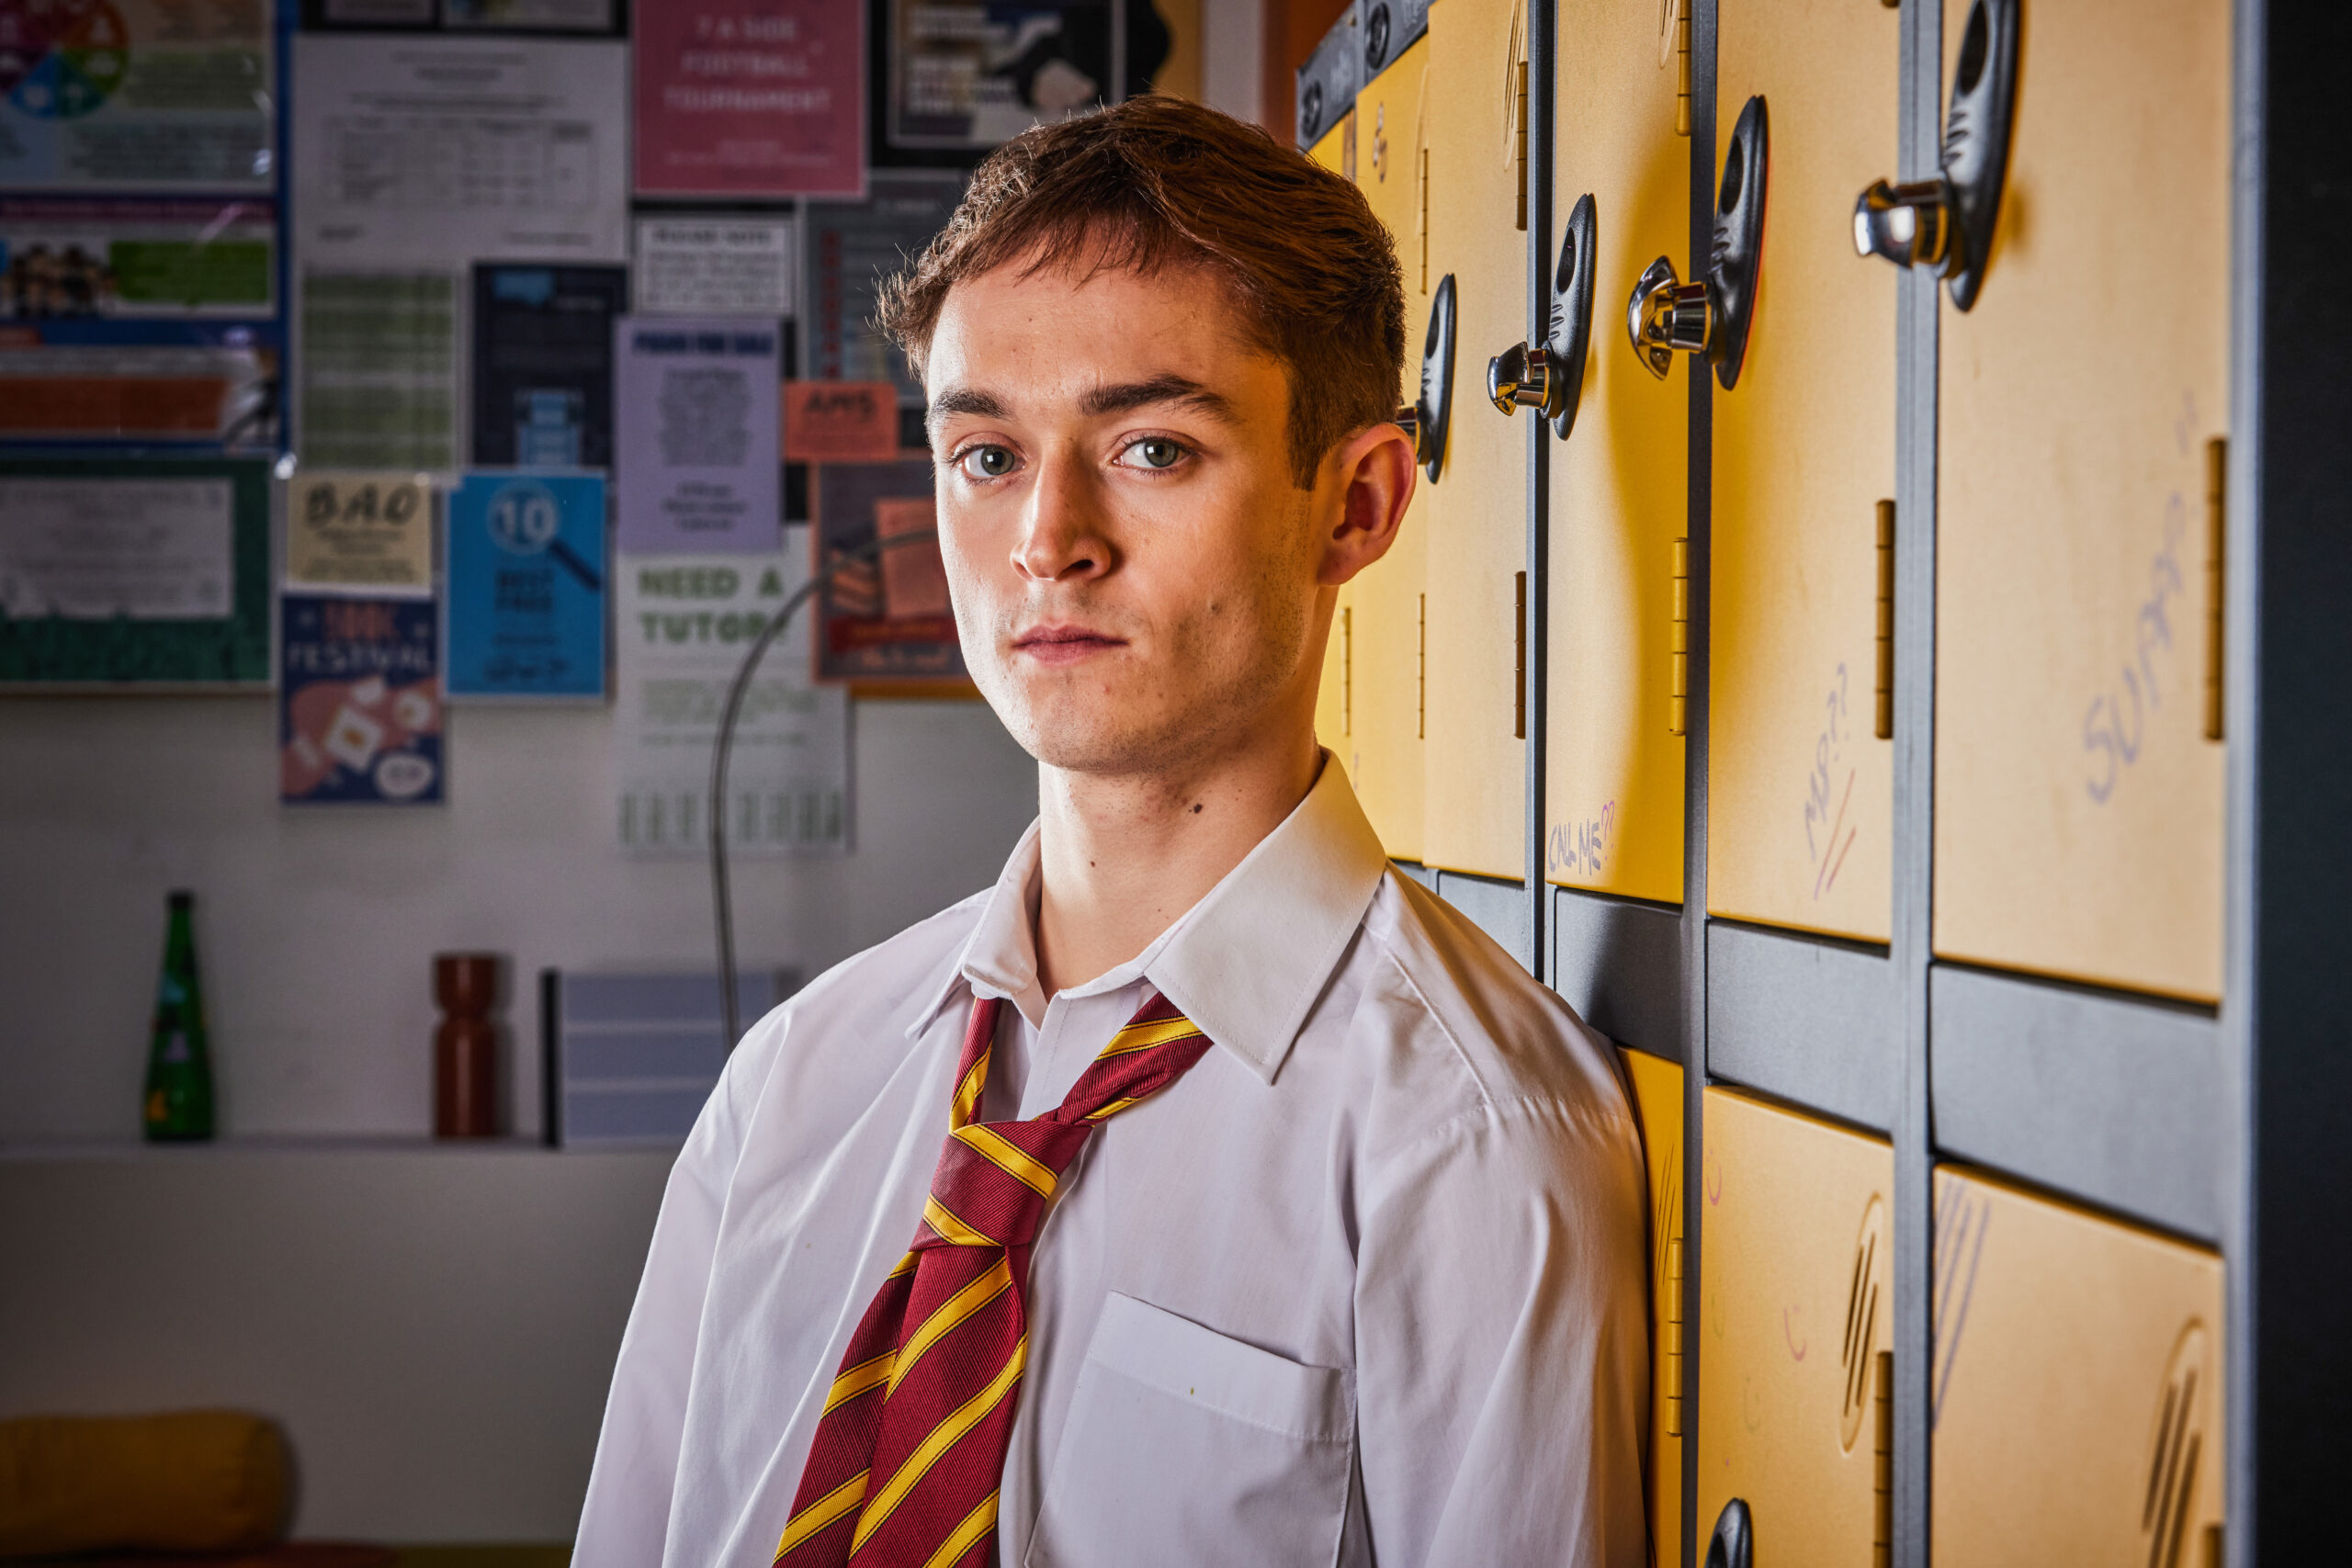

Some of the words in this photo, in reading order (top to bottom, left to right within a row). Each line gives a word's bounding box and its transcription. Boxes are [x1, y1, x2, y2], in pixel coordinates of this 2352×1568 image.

[680, 51, 811, 78] FOOTBALL
[662, 85, 831, 113] TOURNAMENT
[497, 498, 555, 543] 10
[639, 568, 739, 597] NEED
[757, 567, 784, 596] A
[1548, 820, 1577, 874] CALL
